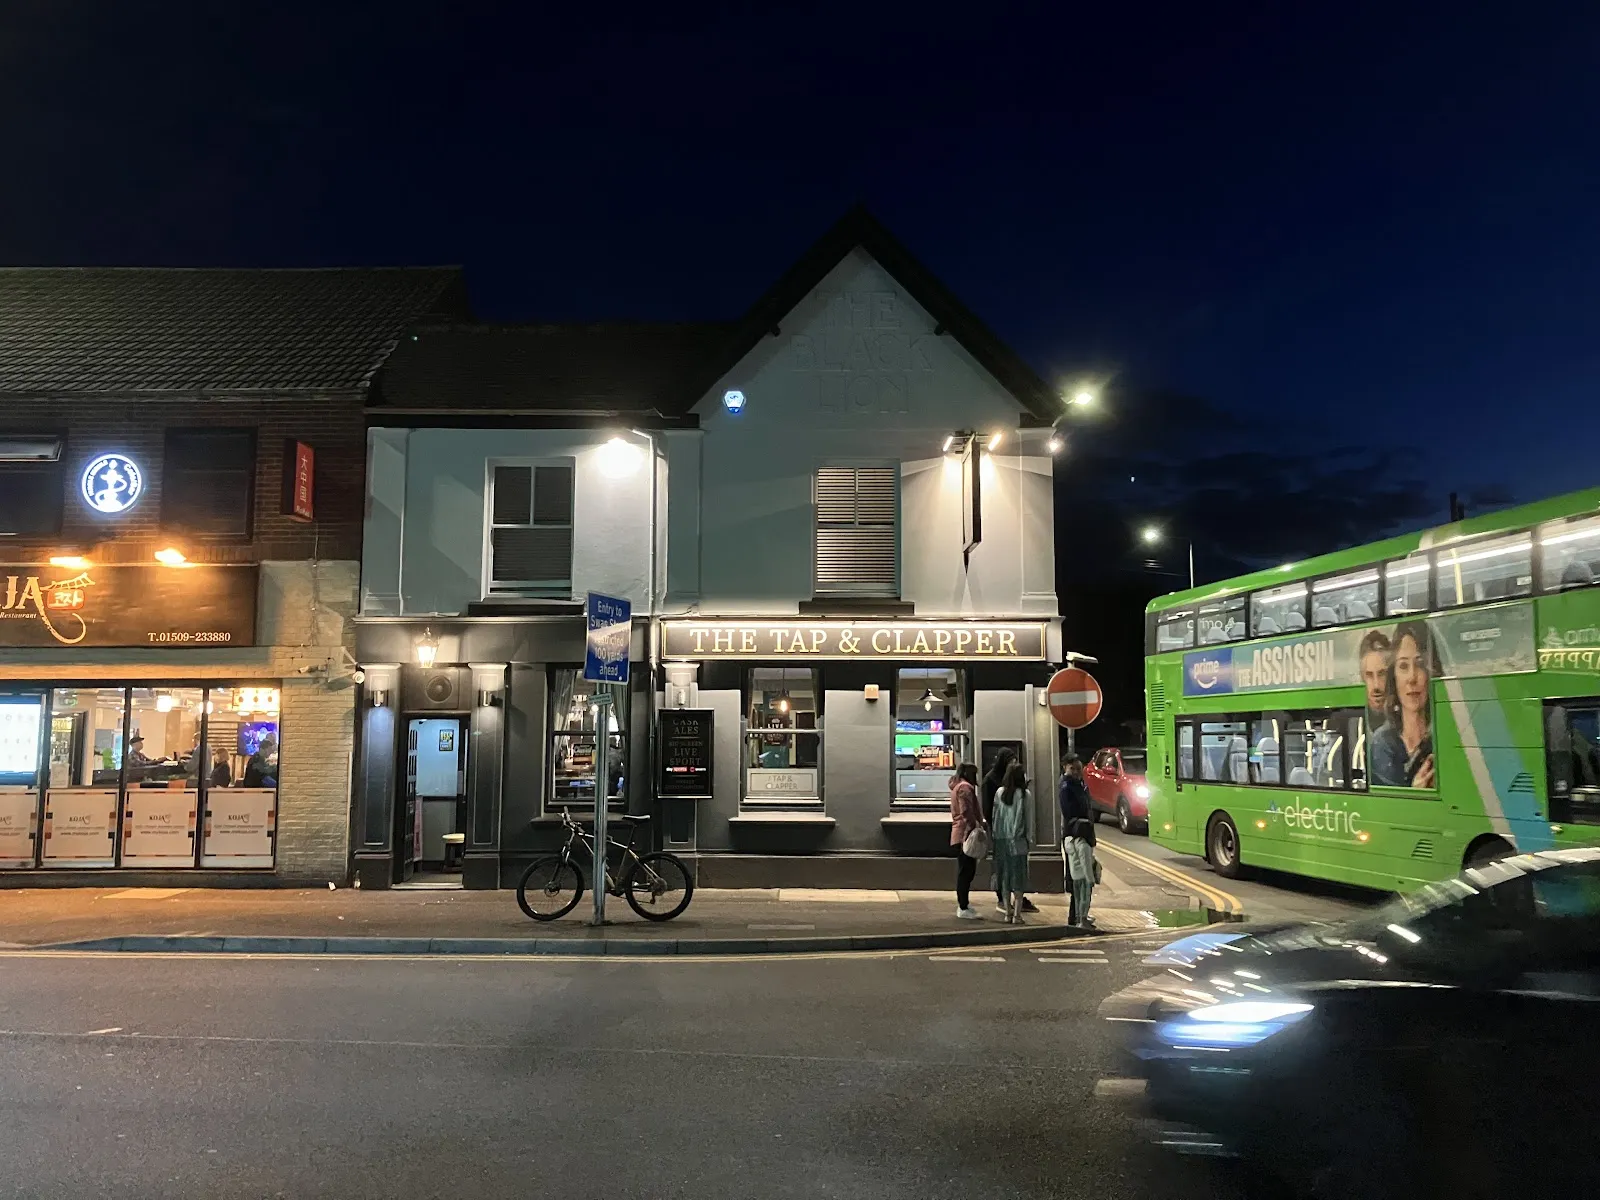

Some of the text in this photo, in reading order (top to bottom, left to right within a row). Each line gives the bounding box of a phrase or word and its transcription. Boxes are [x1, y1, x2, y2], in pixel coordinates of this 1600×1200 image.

[816, 291, 901, 330] THE
[789, 331, 934, 372] BLACK
[816, 375, 910, 414] LION
[597, 600, 623, 617] Entry to
[147, 632, 231, 642] T.01509-233880
[689, 628, 1018, 656] THE TAP & CLAPPER
[594, 646, 624, 663] 100 yards
[599, 664, 619, 676] ahead
[1193, 658, 1220, 680] prime
[1238, 640, 1335, 688] THE ASSASSIN
[674, 726, 699, 735] ALES
[674, 748, 699, 757] LIVE
[669, 757, 701, 766] SPORT
[765, 782, 798, 790] CAPPER
[1284, 796, 1362, 835] electric
